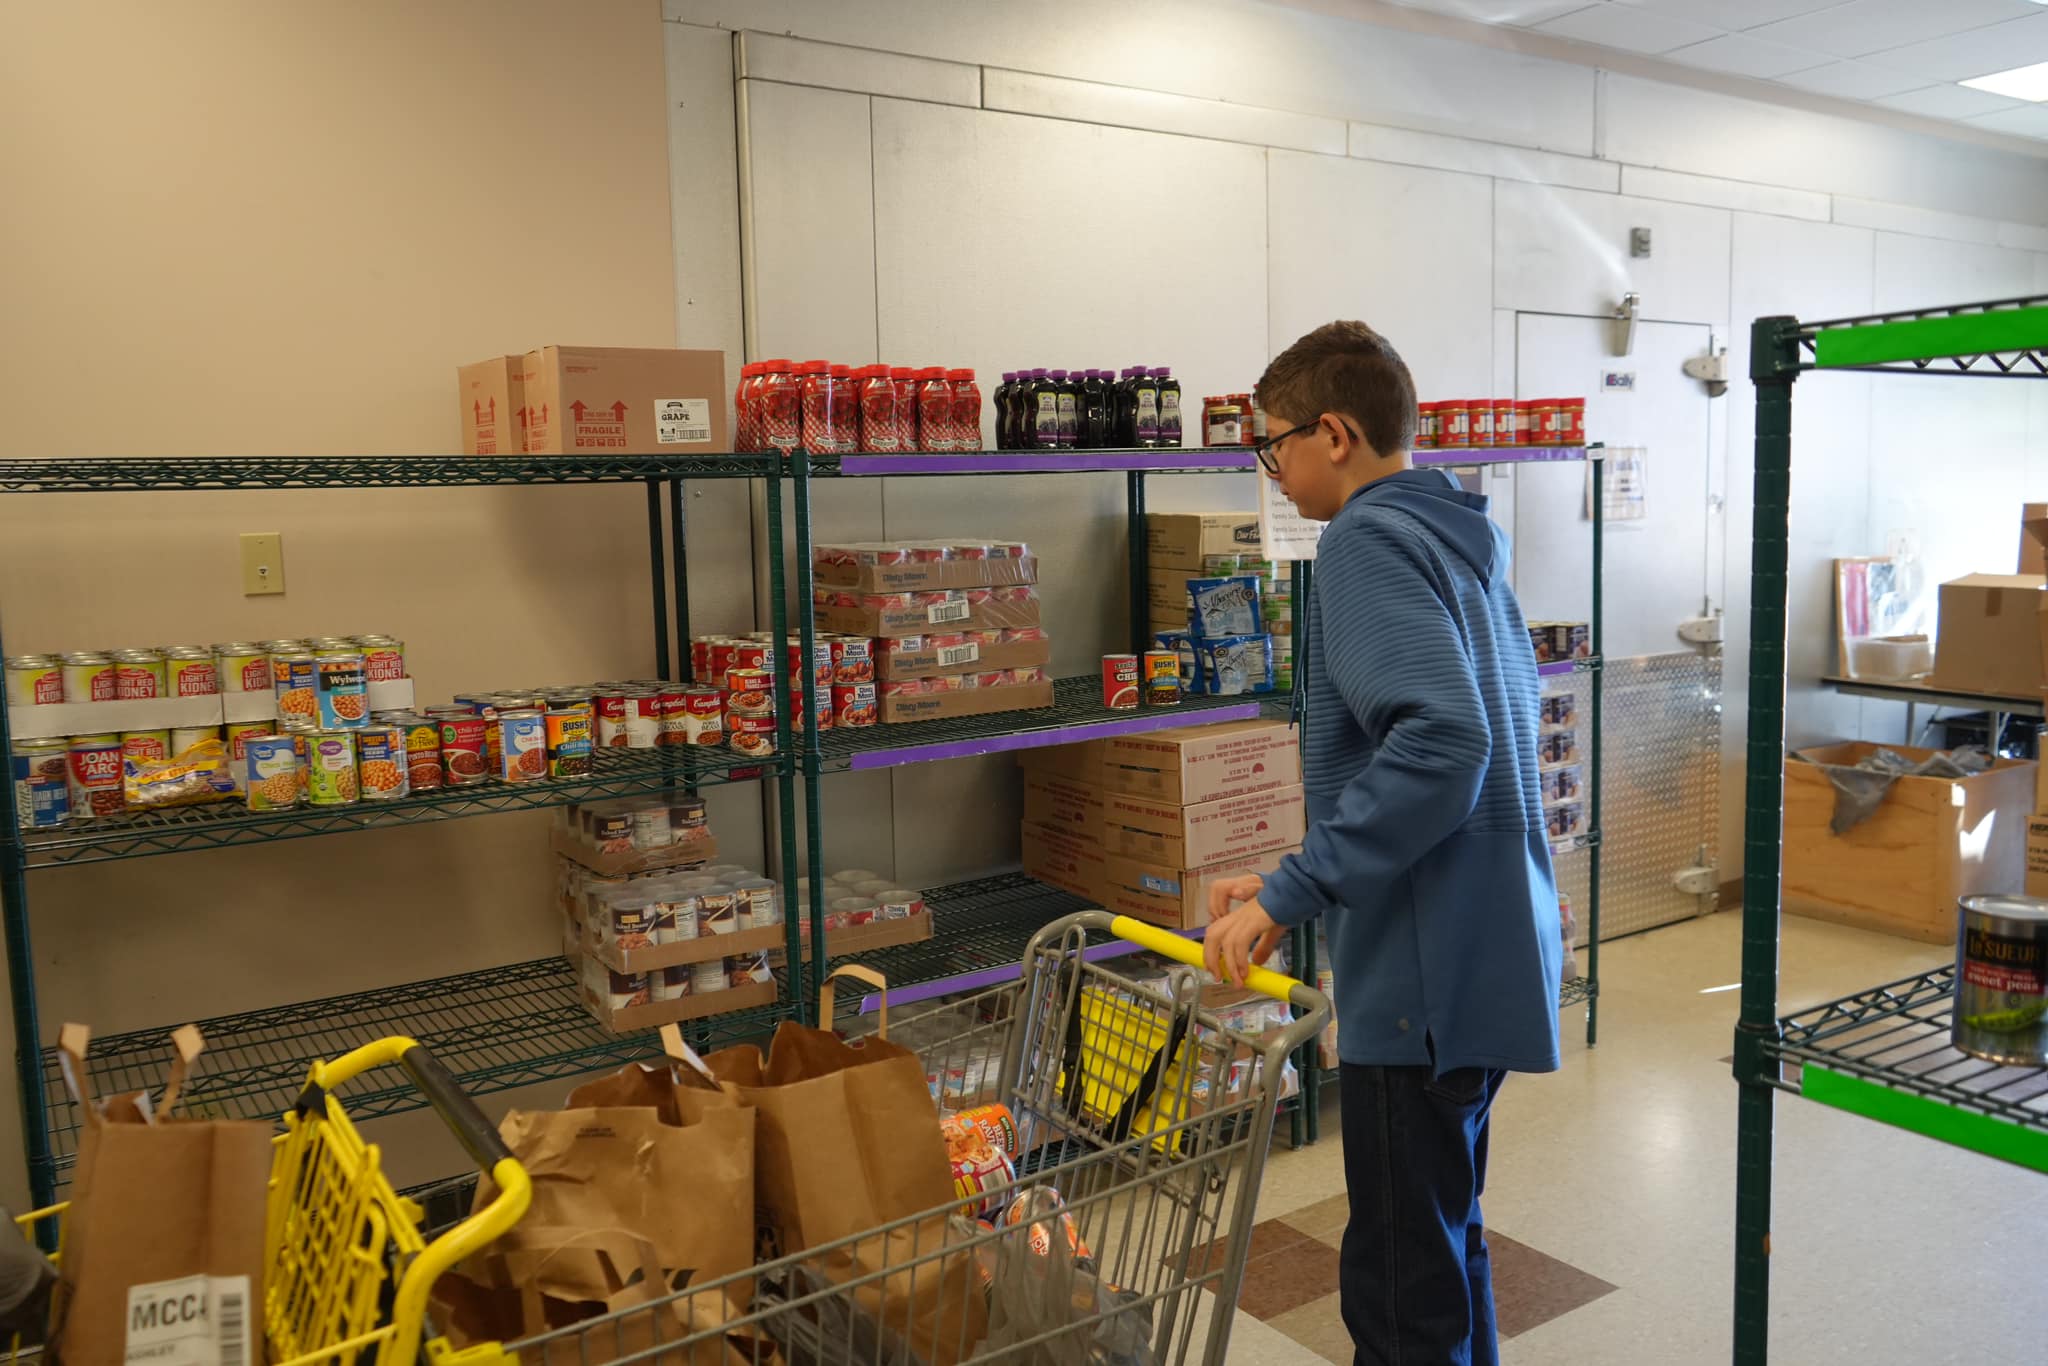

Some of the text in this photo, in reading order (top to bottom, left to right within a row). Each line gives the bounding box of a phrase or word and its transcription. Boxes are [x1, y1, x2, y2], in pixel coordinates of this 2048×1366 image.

[661, 413, 690, 421] GRAPE
[578, 426, 621, 434] FRAGILE
[847, 644, 865, 652] Dinty
[367, 661, 388, 669] LIGHT
[80, 752, 119, 766] JOAN
[87, 763, 118, 775] ARC
[1967, 971, 2039, 992] sweet peas
[132, 1294, 208, 1331] MCC
